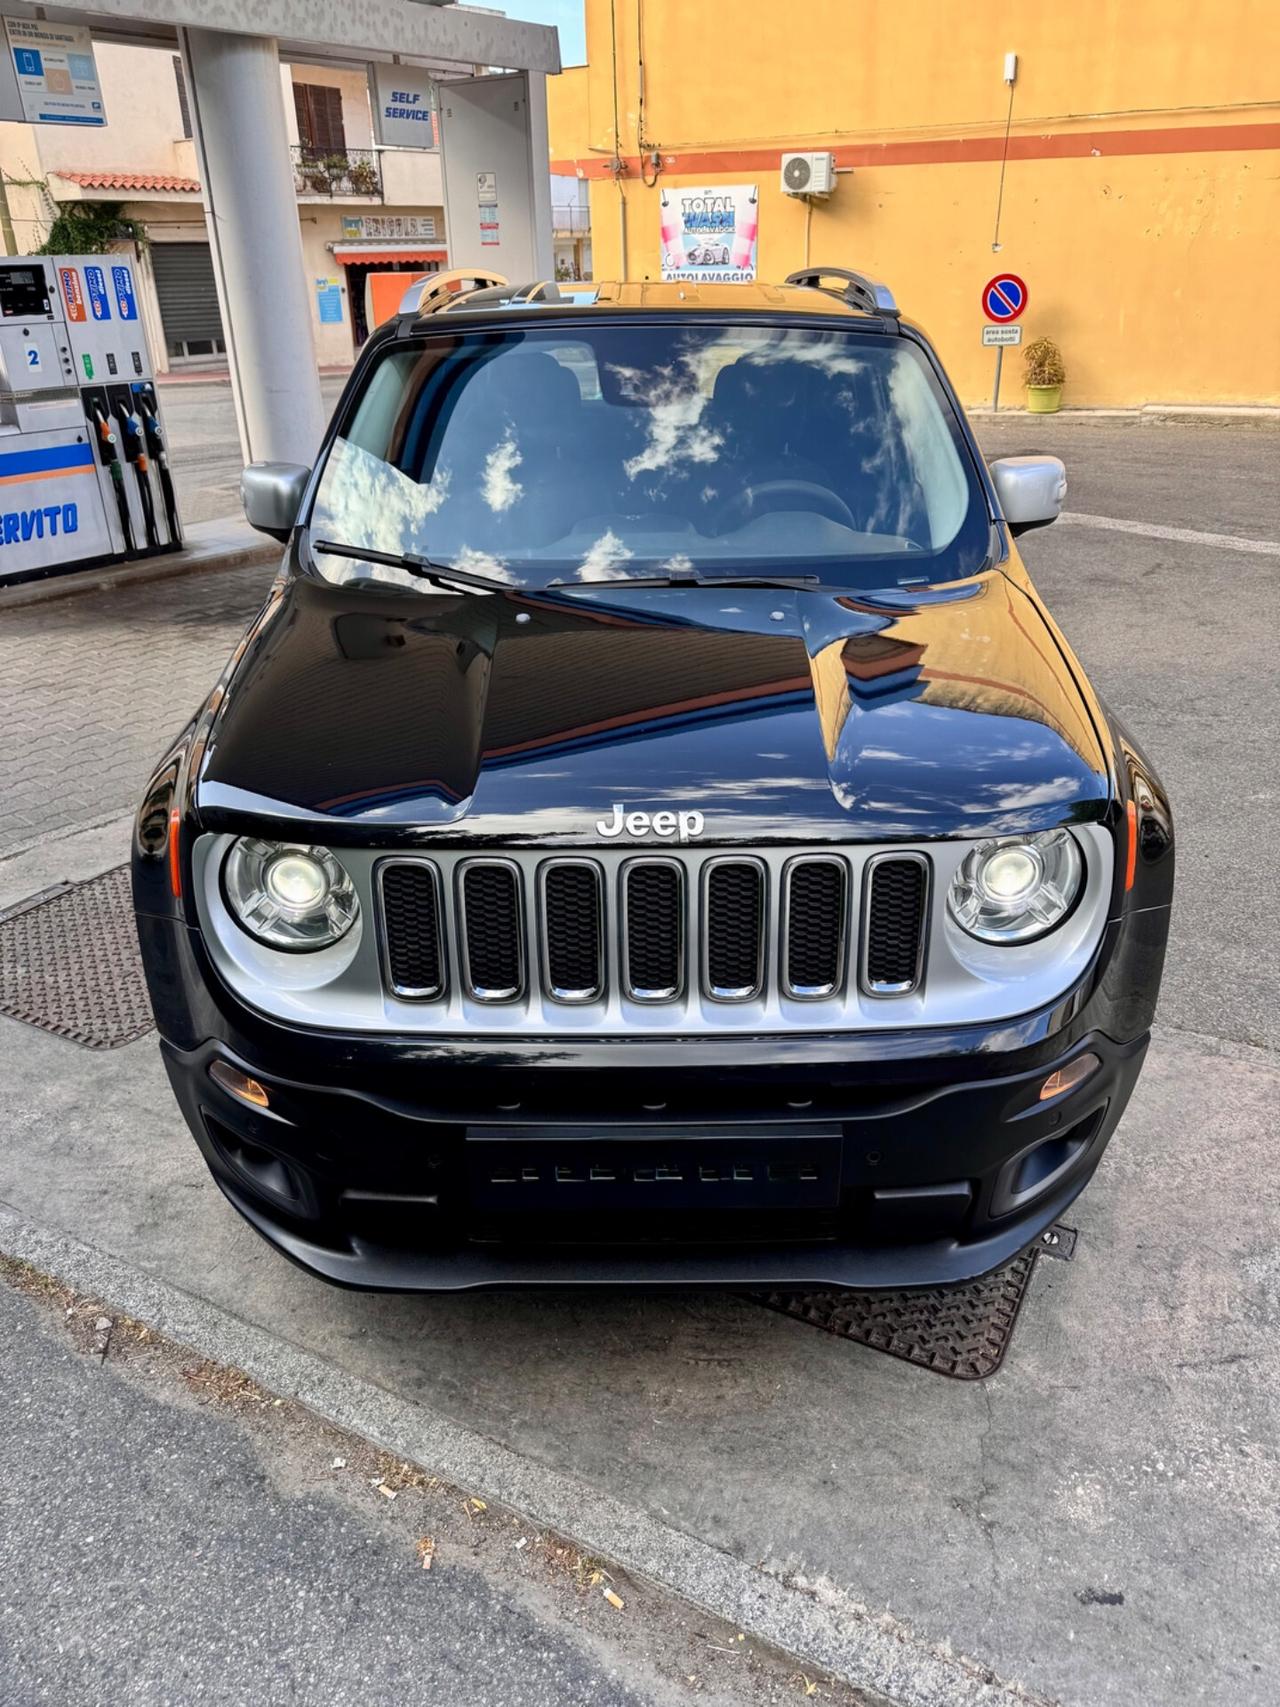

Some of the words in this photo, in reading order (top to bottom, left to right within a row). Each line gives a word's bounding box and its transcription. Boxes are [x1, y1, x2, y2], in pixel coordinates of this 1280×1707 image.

[391, 91, 421, 105] SELF
[385, 107, 429, 121] SERVICE
[682, 197, 735, 213] TOTAL
[95, 269, 105, 295] diesel
[122, 269, 131, 295] diesel
[666, 272, 754, 282] AUTOLAVAGGIO
[27, 350, 40, 366] 2
[0, 502, 78, 546] RVITO
[596, 803, 705, 844] Jeep
